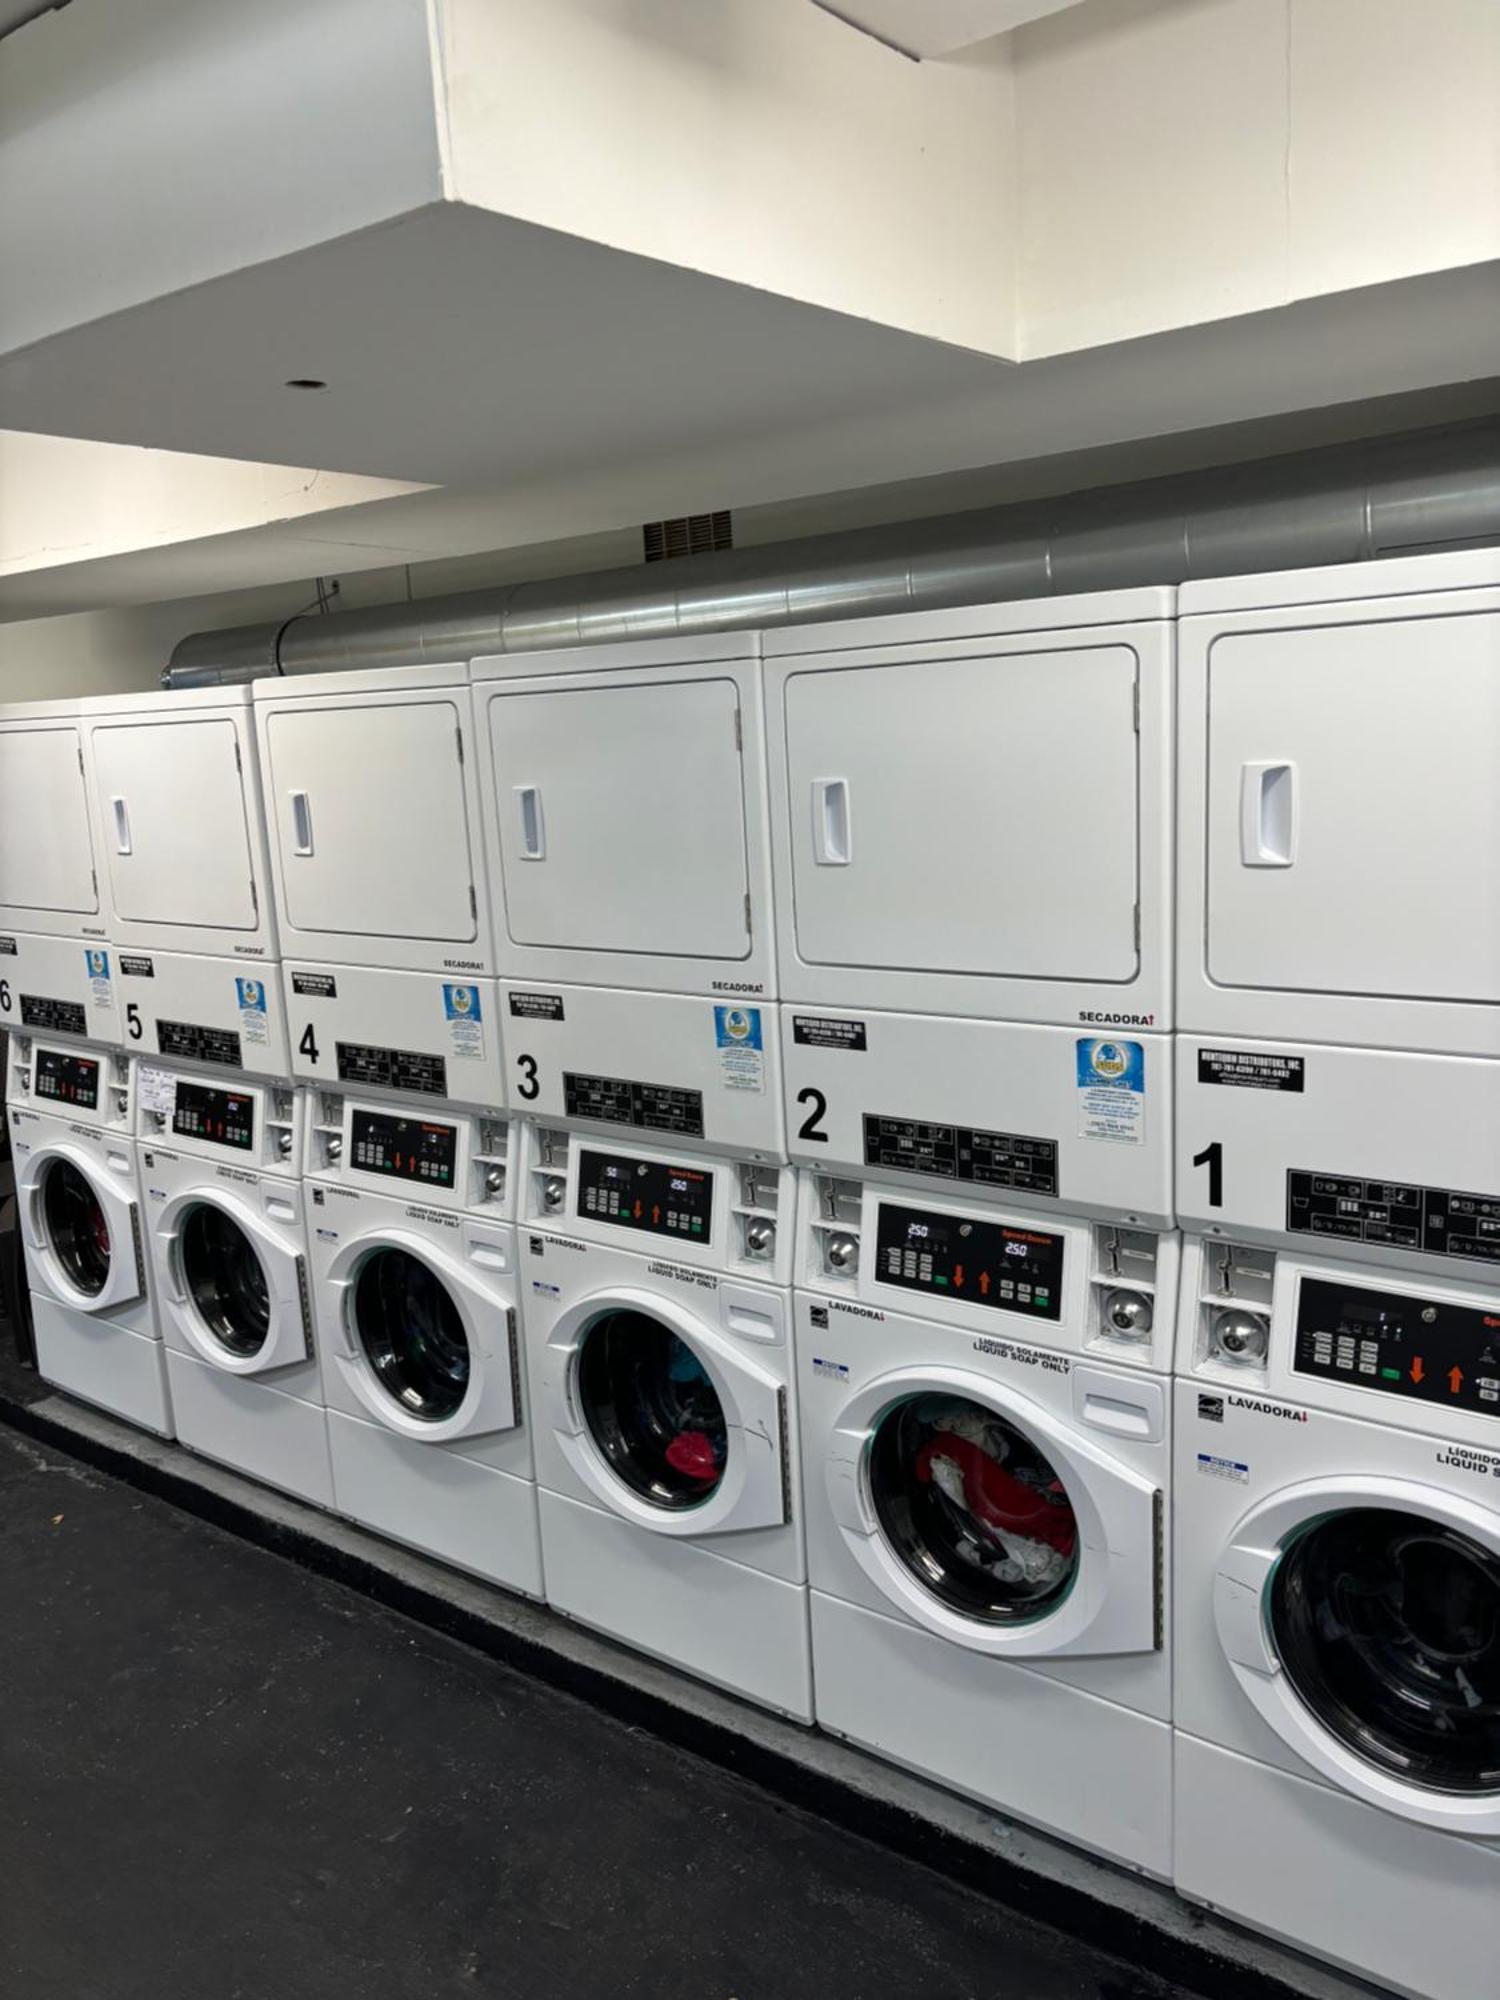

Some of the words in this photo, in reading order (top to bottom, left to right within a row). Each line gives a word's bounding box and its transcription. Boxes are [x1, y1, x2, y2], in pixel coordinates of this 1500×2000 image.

[0, 979, 11, 1012] 6
[712, 981, 760, 993] SECADORA
[126, 1003, 143, 1040] 5
[1079, 1011, 1149, 1025] SECADORA
[299, 1023, 319, 1064] 4
[517, 1054, 540, 1100] 3
[797, 1088, 829, 1143] 2
[1193, 1142, 1222, 1207] 1
[828, 1301, 880, 1321] LAVADORA
[973, 1342, 1008, 1358] LIQUID
[1011, 1352, 1039, 1366] SOAP
[1041, 1360, 1070, 1374] ONLY
[1228, 1396, 1302, 1422] LAVADORA
[1437, 1453, 1488, 1473] LIQUID
